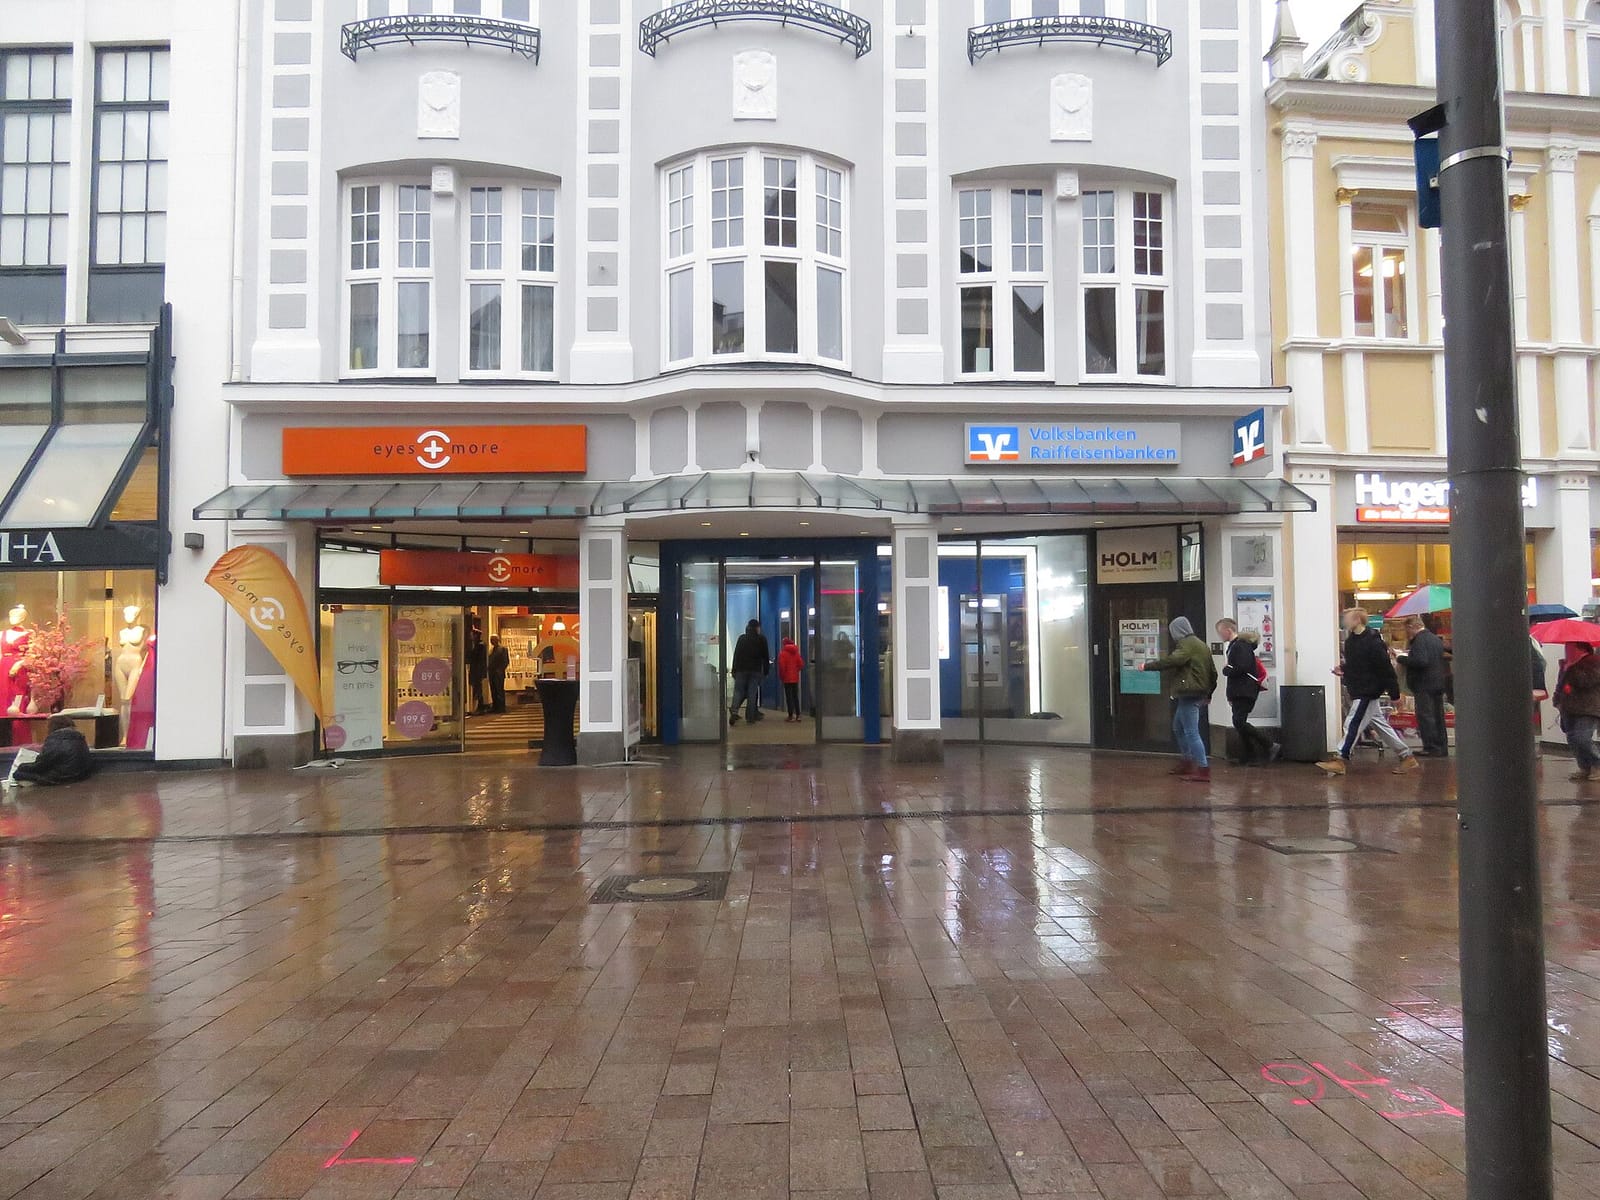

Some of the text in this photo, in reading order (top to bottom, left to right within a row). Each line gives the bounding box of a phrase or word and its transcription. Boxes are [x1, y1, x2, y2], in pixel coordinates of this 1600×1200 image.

[1029, 426, 1137, 442] Volksbanken
[373, 442, 499, 458] eyes more
[1030, 445, 1177, 460] Raiffeisenbanken
[1101, 551, 1158, 567] HOLM
[511, 564, 545, 574] more
[1121, 622, 1150, 631] HOLM
[421, 671, 433, 682] 89
[402, 714, 419, 725] 199
